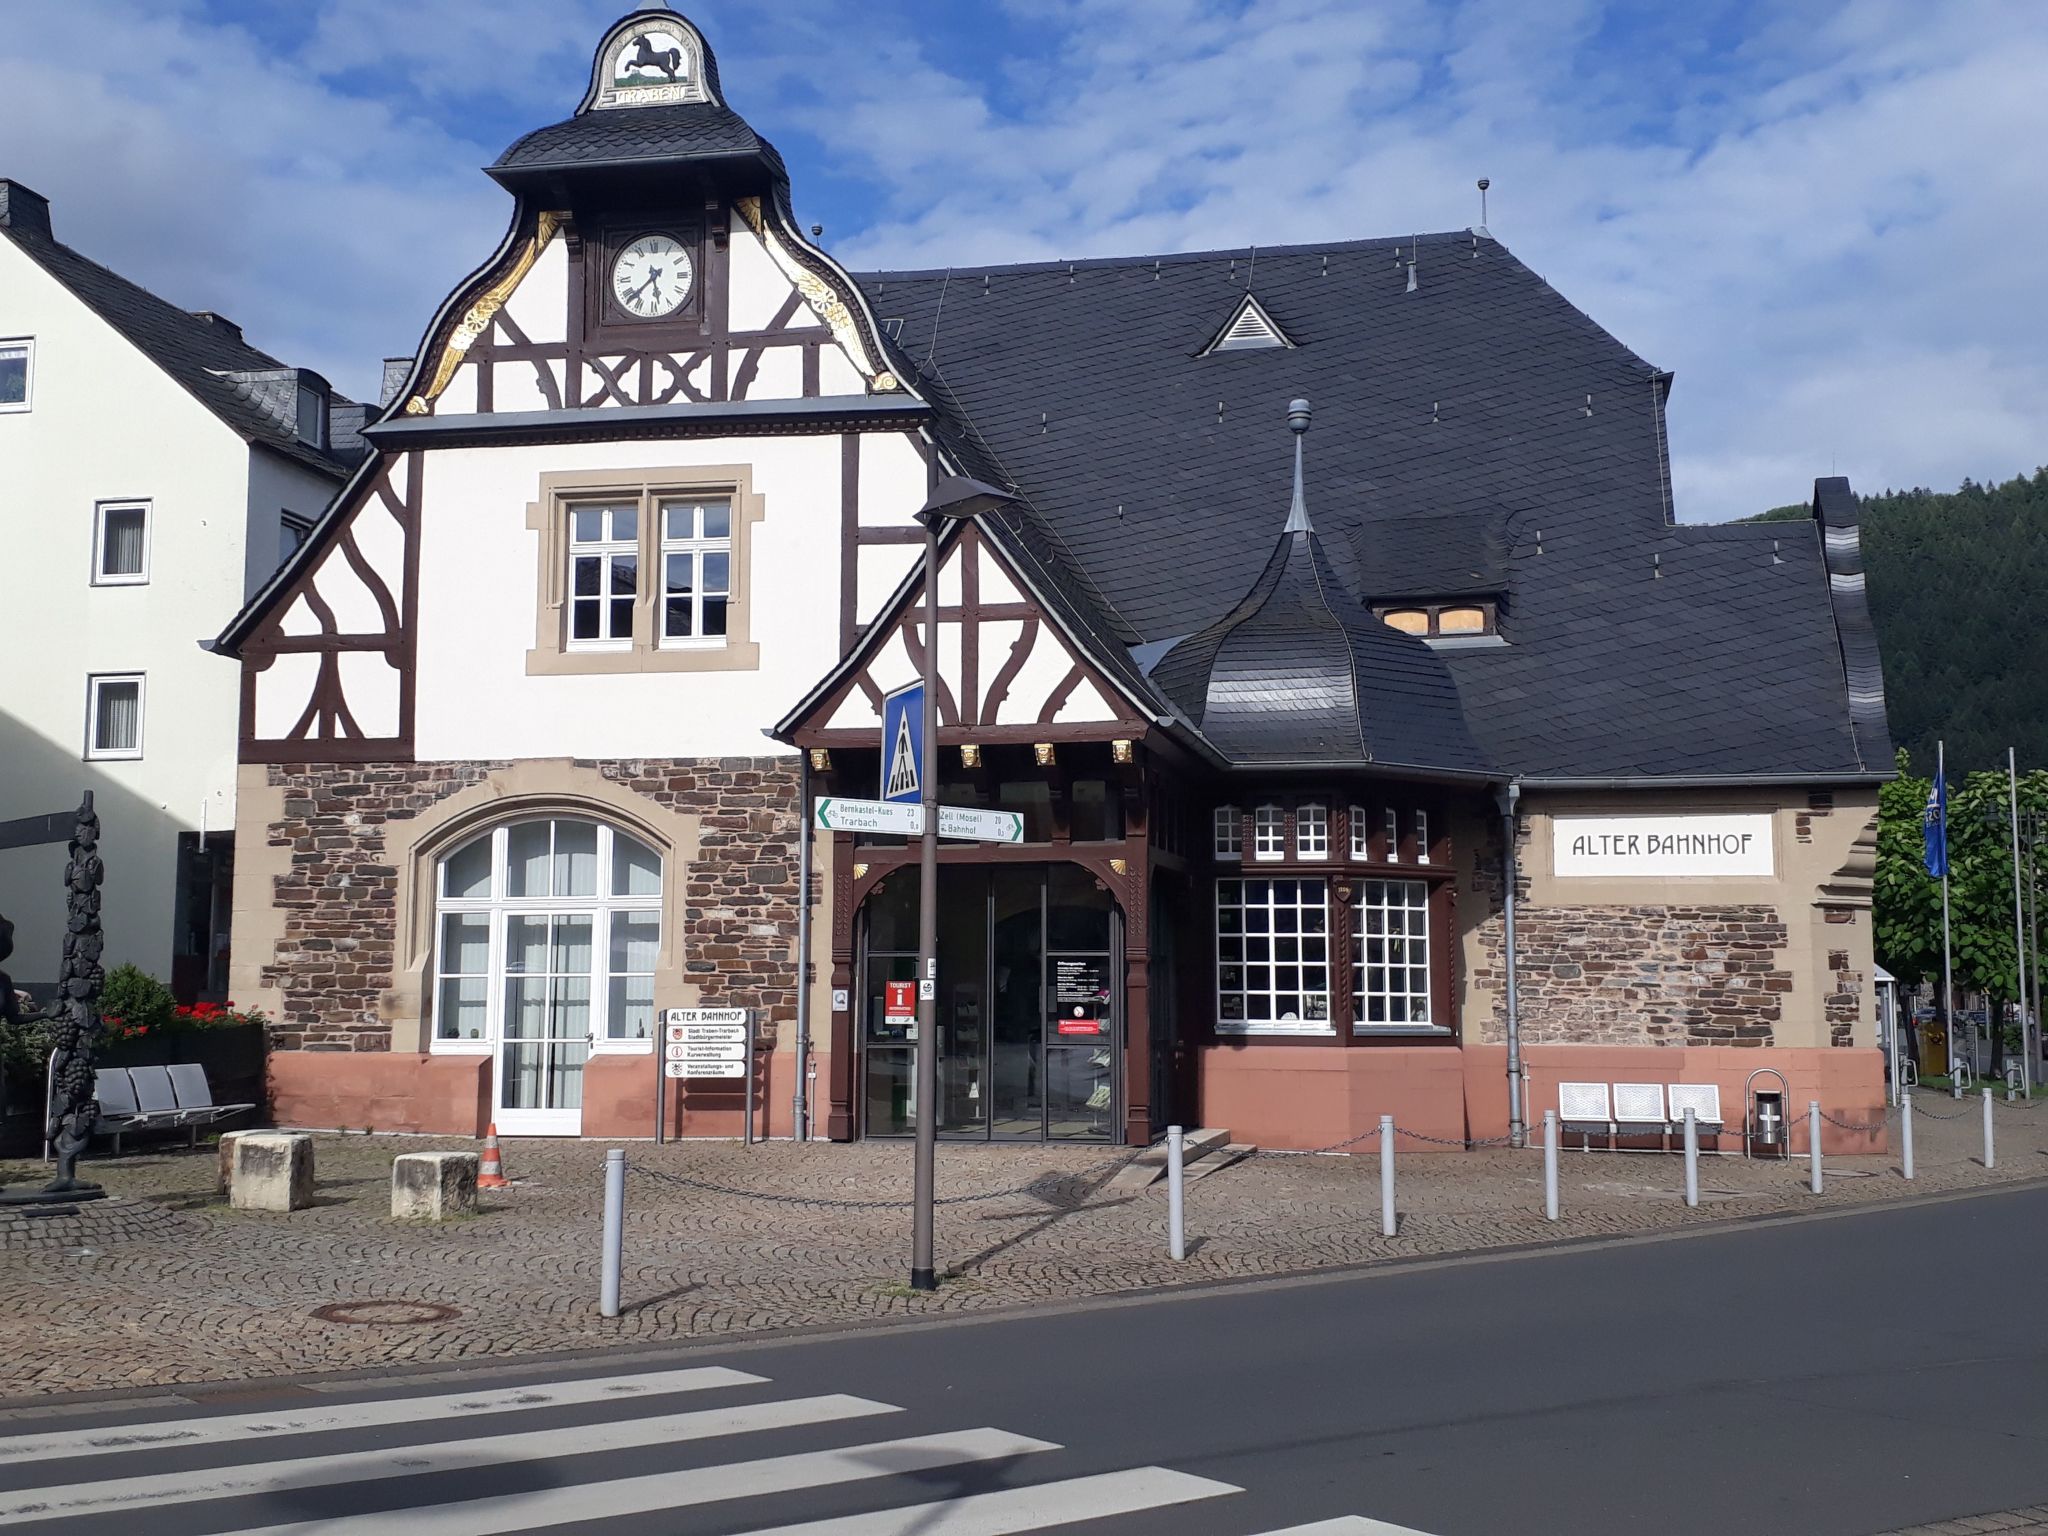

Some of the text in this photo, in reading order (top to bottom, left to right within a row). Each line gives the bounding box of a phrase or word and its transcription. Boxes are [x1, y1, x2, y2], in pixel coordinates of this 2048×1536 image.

[840, 804, 915, 817] Bernkastel-Kues 23
[840, 816, 878, 828] Trarbach
[940, 811, 1002, 824] Zell (Mosel) 20
[948, 824, 976, 834] Bahnhof
[1572, 834, 1753, 856] ALTER BAHNHOF
[671, 1011, 742, 1021] ALTER BAHNHOF
